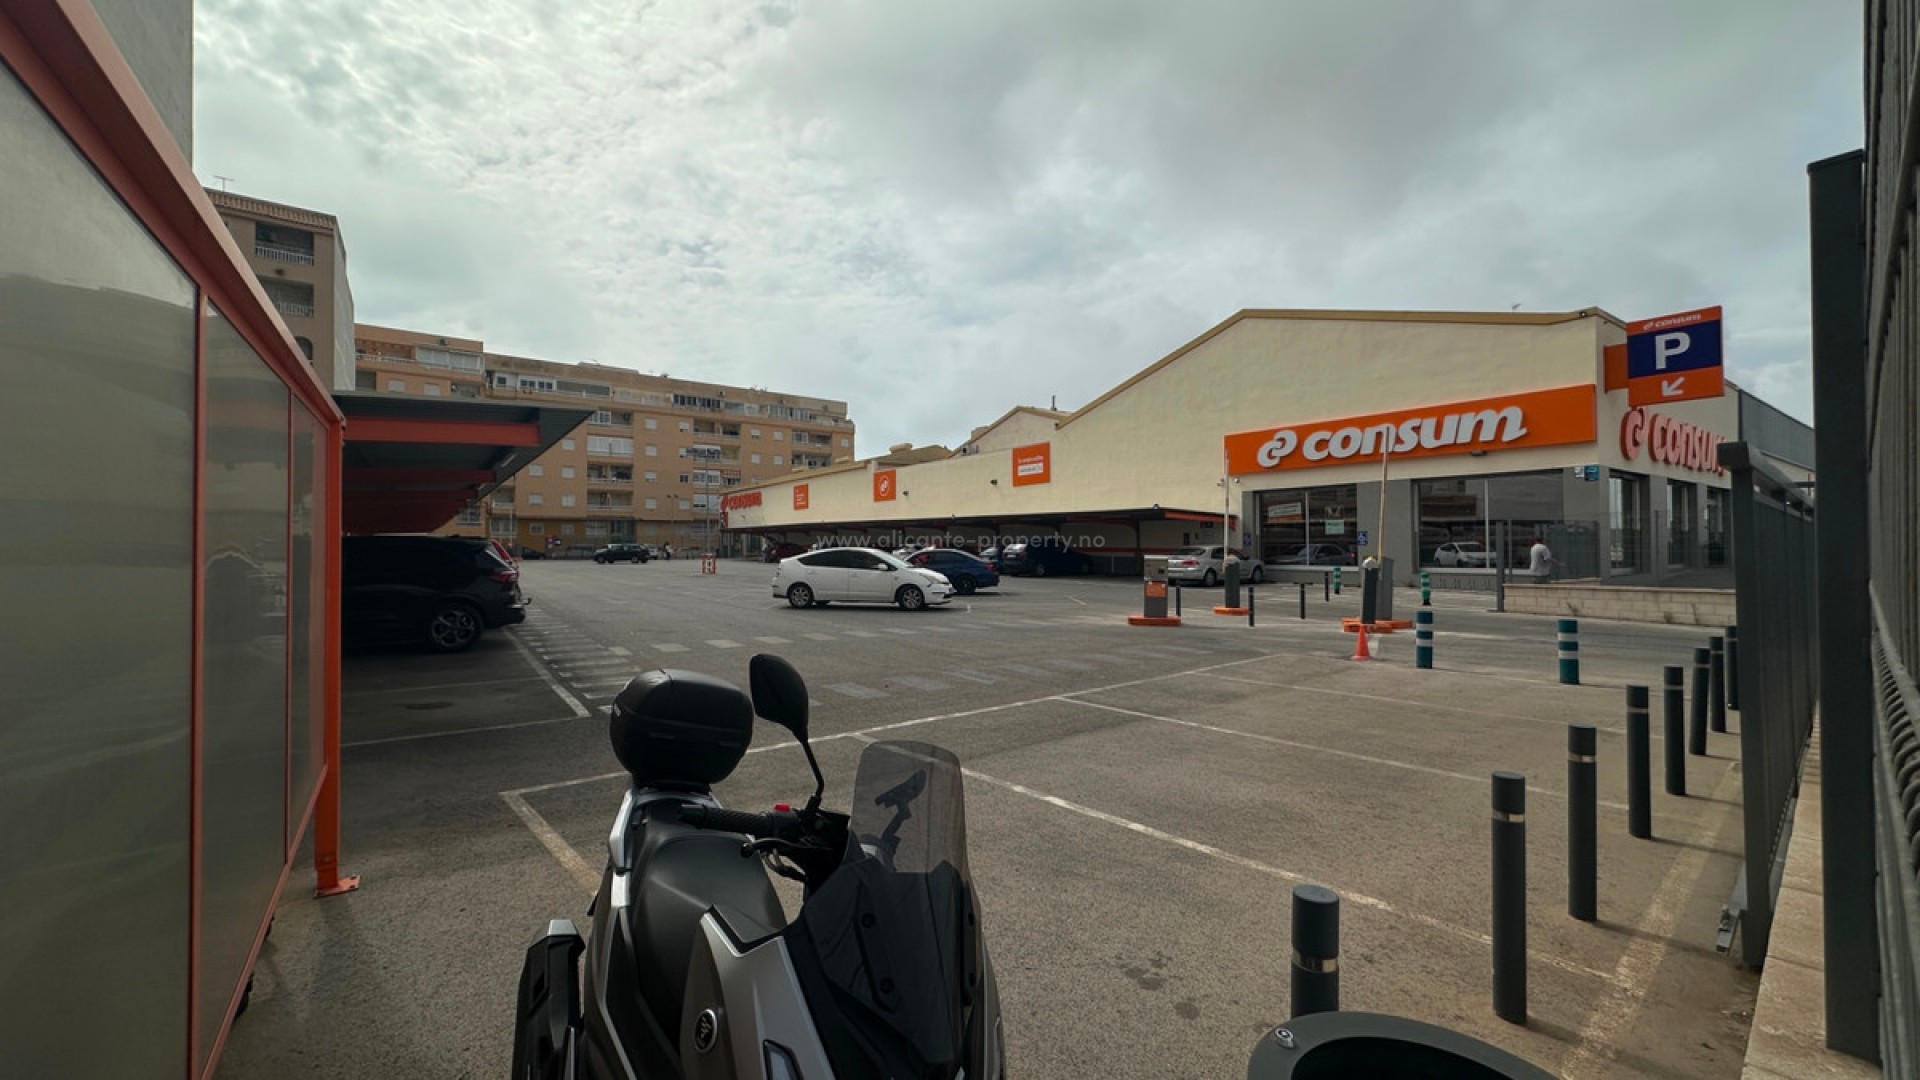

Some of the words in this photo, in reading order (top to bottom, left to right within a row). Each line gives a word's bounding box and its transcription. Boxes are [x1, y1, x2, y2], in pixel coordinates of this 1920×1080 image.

[1655, 313, 1702, 328] consum
[1655, 332, 1691, 370] P
[1303, 405, 1527, 461] consum
